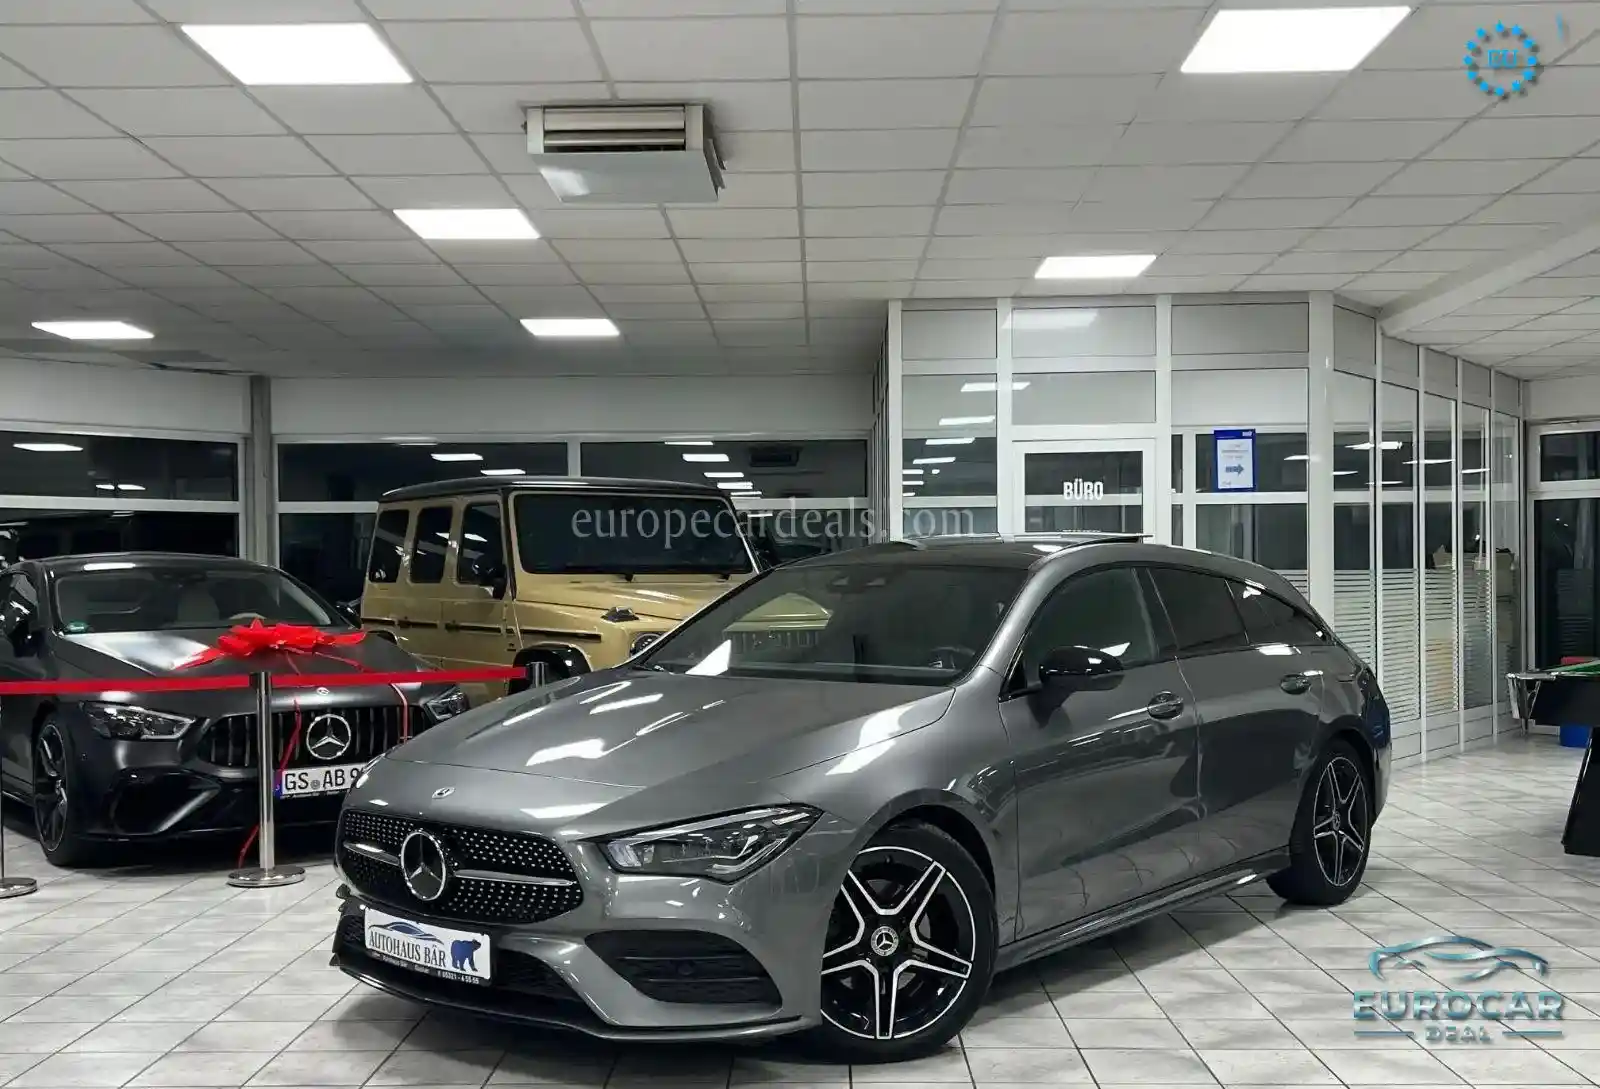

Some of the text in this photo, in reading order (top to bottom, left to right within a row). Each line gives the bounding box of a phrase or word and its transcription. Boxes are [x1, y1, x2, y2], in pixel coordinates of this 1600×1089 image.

[1063, 478, 1104, 500] BÜRO
[284, 772, 309, 791] GS
[322, 768, 346, 788] AB
[369, 930, 421, 961] AUTOHAUS
[424, 945, 447, 968] BÄR
